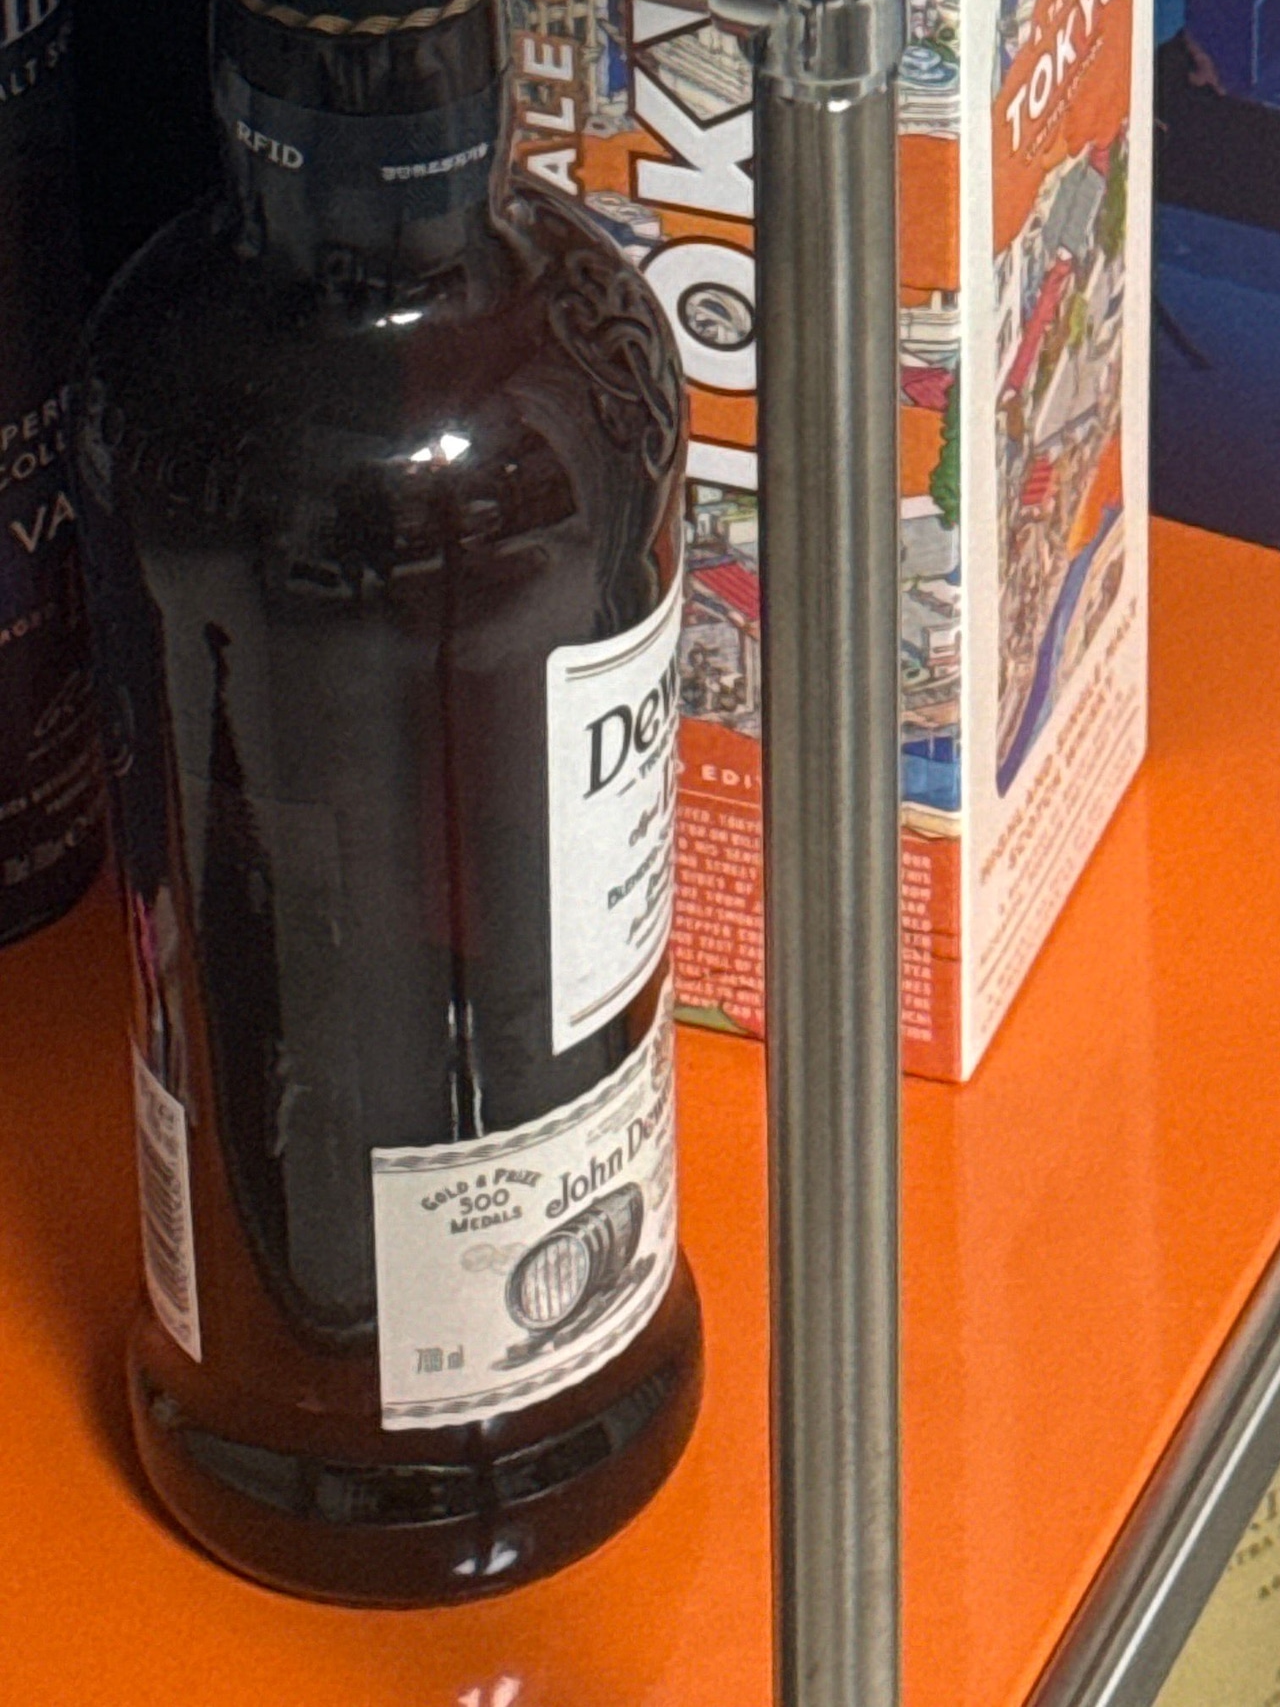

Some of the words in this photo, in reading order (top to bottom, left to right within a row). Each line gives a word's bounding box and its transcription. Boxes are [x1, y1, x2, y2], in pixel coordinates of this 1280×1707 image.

[522, 35, 579, 196] ALE
[236, 119, 305, 170] RFID
[701, 763, 762, 790] EDI
[420, 1180, 468, 1212] GOLD
[545, 1147, 624, 1220] John
[459, 1187, 511, 1217] 500
[450, 1205, 523, 1234] MEDALS
